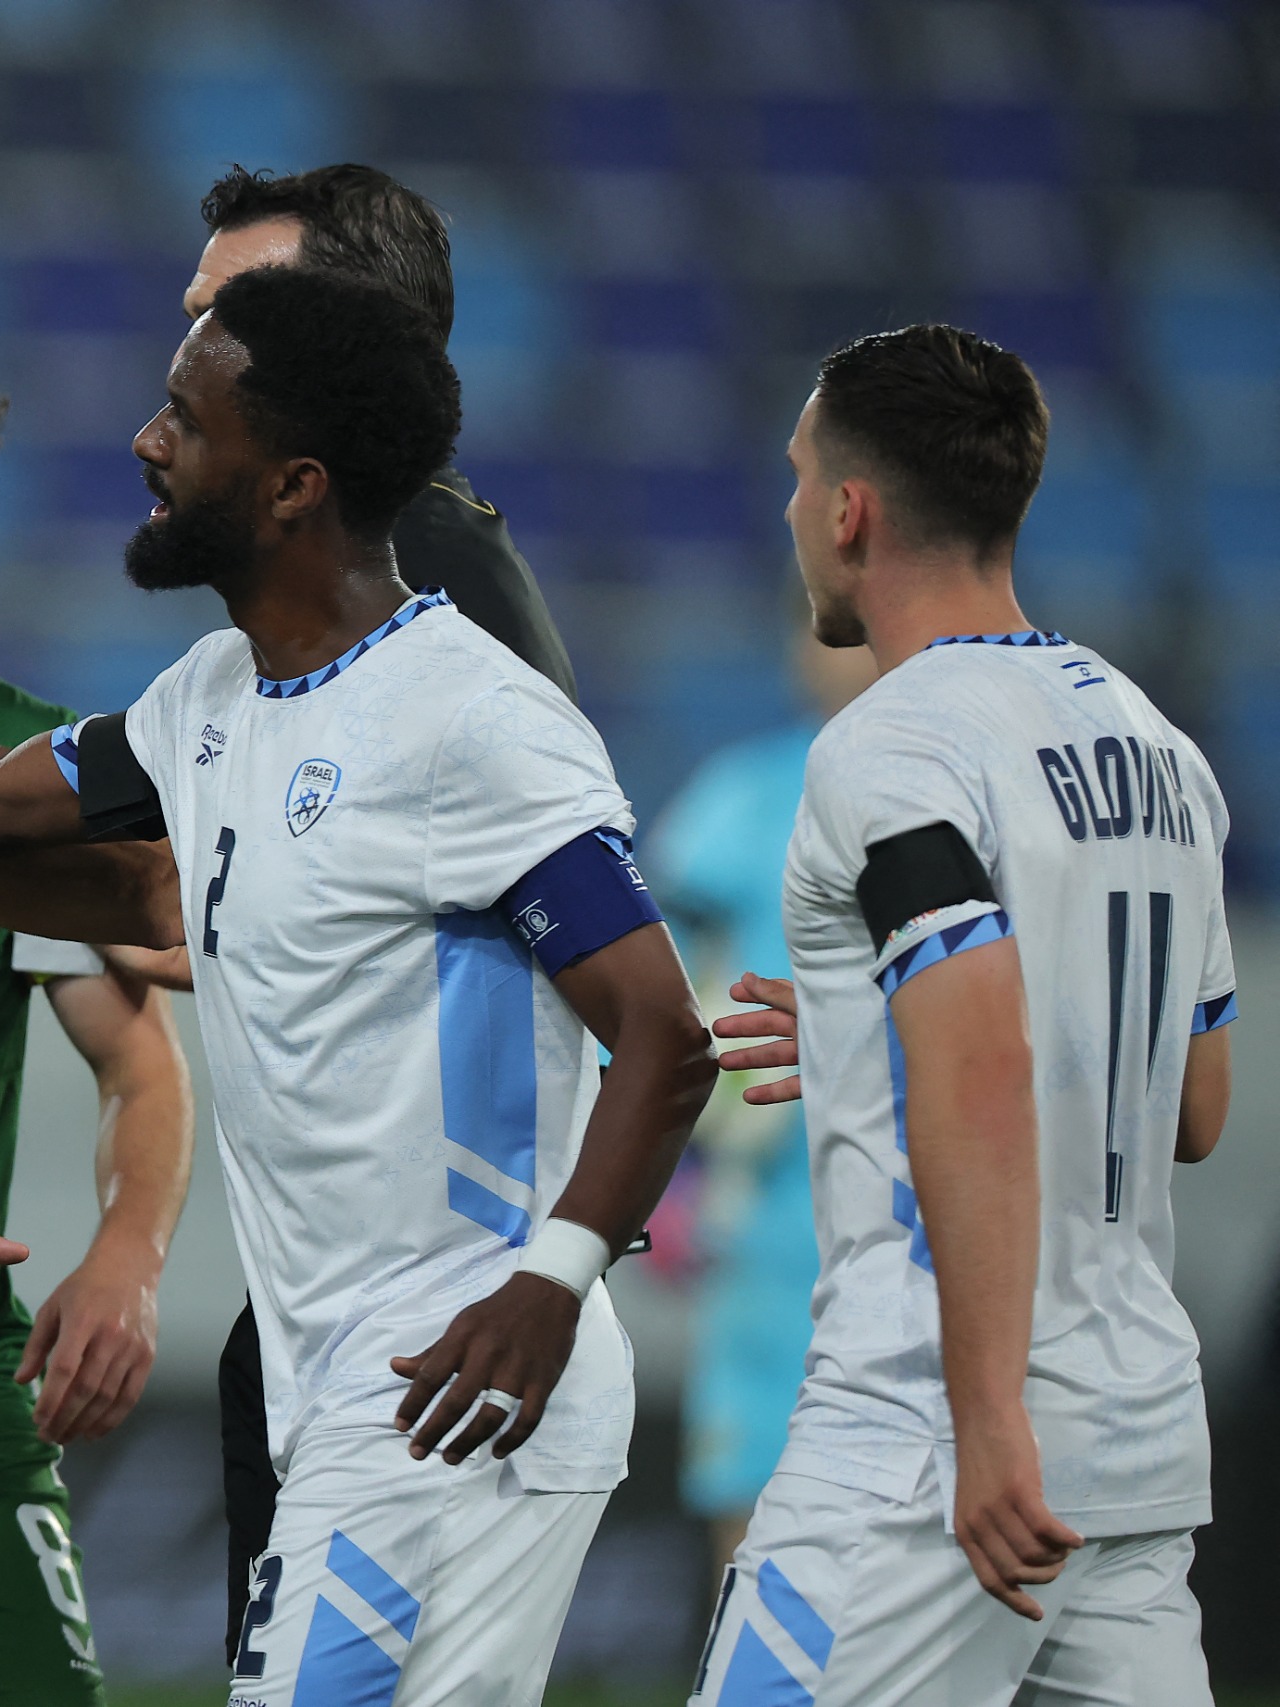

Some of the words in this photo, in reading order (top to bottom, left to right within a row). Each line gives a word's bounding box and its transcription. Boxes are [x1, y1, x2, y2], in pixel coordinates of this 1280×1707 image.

[302, 765, 333, 781] ISRAEL
[204, 826, 236, 959] 2
[1105, 891, 1174, 1223] 11
[15, 1502, 88, 1624] 8
[235, 1555, 283, 1679] 2
